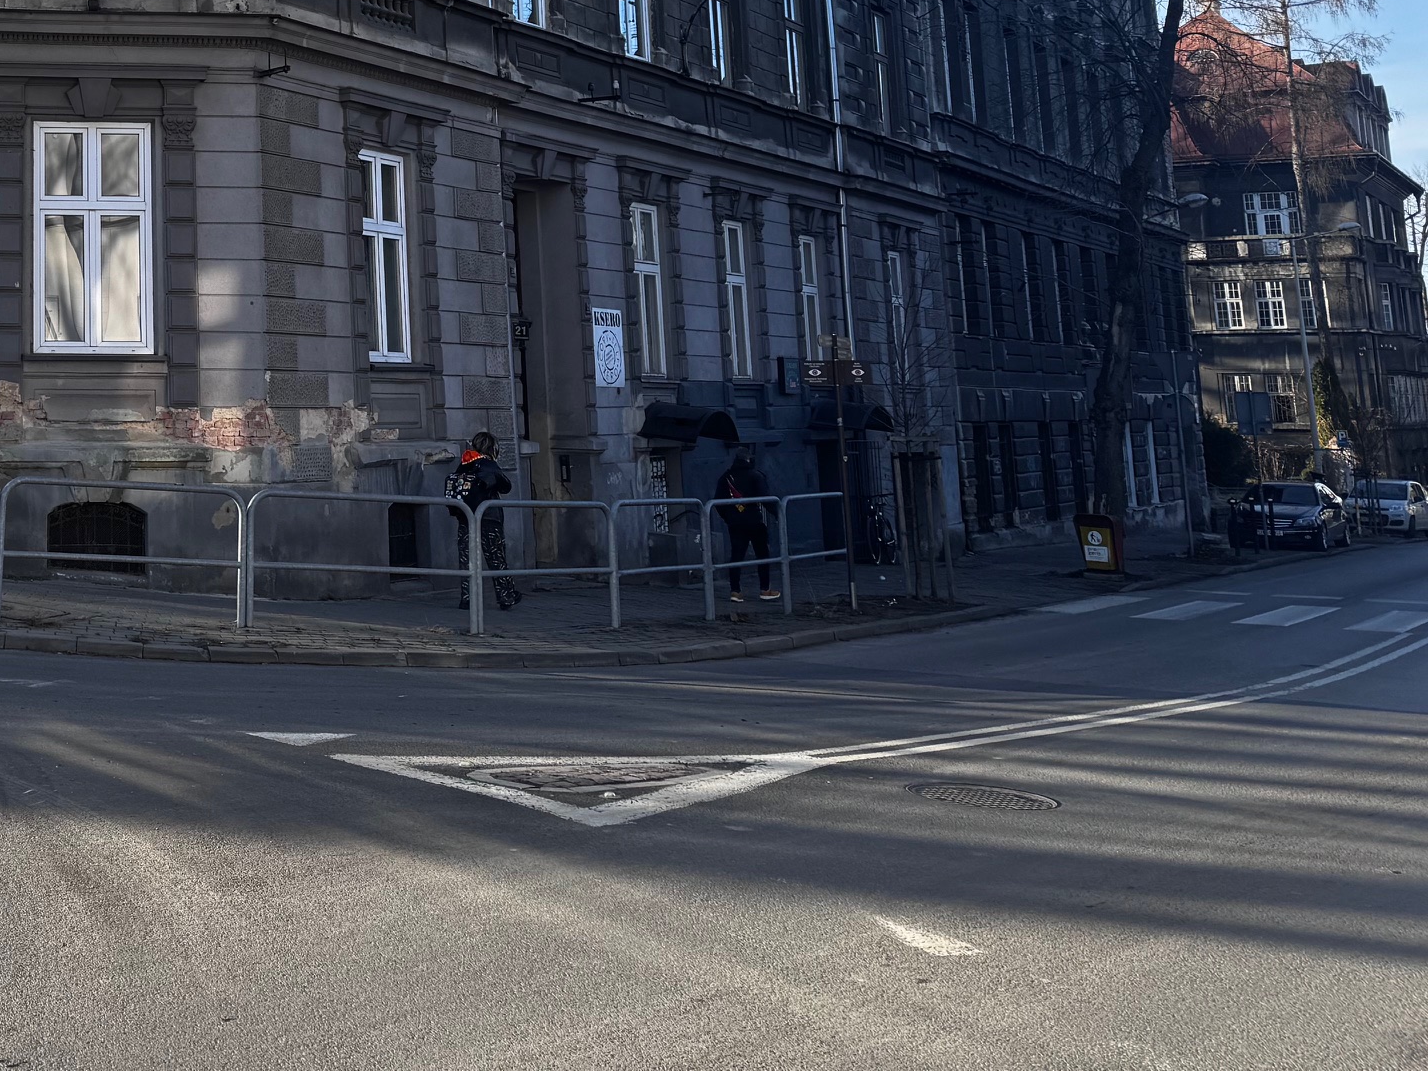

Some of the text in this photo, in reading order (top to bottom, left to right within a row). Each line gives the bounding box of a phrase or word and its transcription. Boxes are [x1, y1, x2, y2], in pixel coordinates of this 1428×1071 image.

[593, 310, 621, 328] KSERO
[515, 326, 527, 336] 21
[1338, 431, 1347, 441] P
